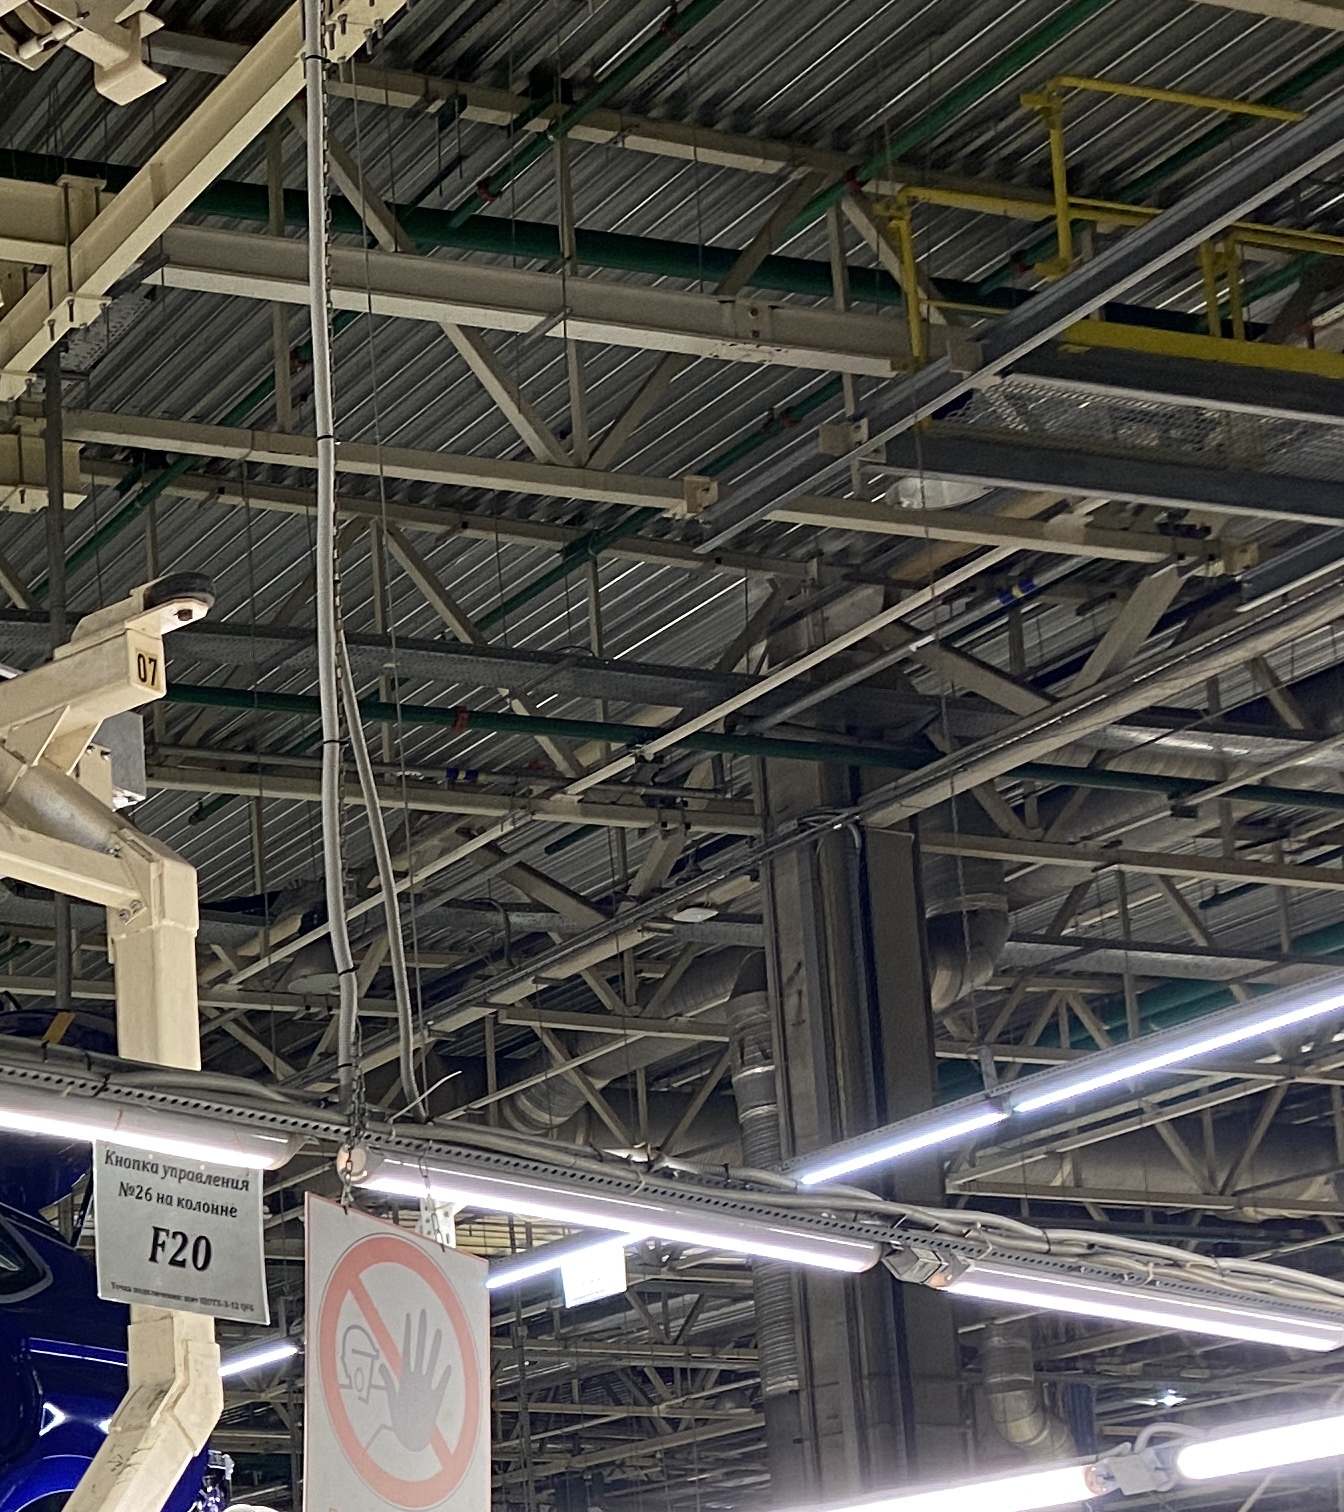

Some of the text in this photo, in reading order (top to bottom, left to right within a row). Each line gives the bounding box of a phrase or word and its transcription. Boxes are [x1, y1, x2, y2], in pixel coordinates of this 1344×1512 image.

[137, 653, 158, 686] 07
[104, 1149, 250, 1192] Кнопка управления
[118, 1181, 239, 1218] №26 на колонне
[148, 1225, 212, 1272] F20
